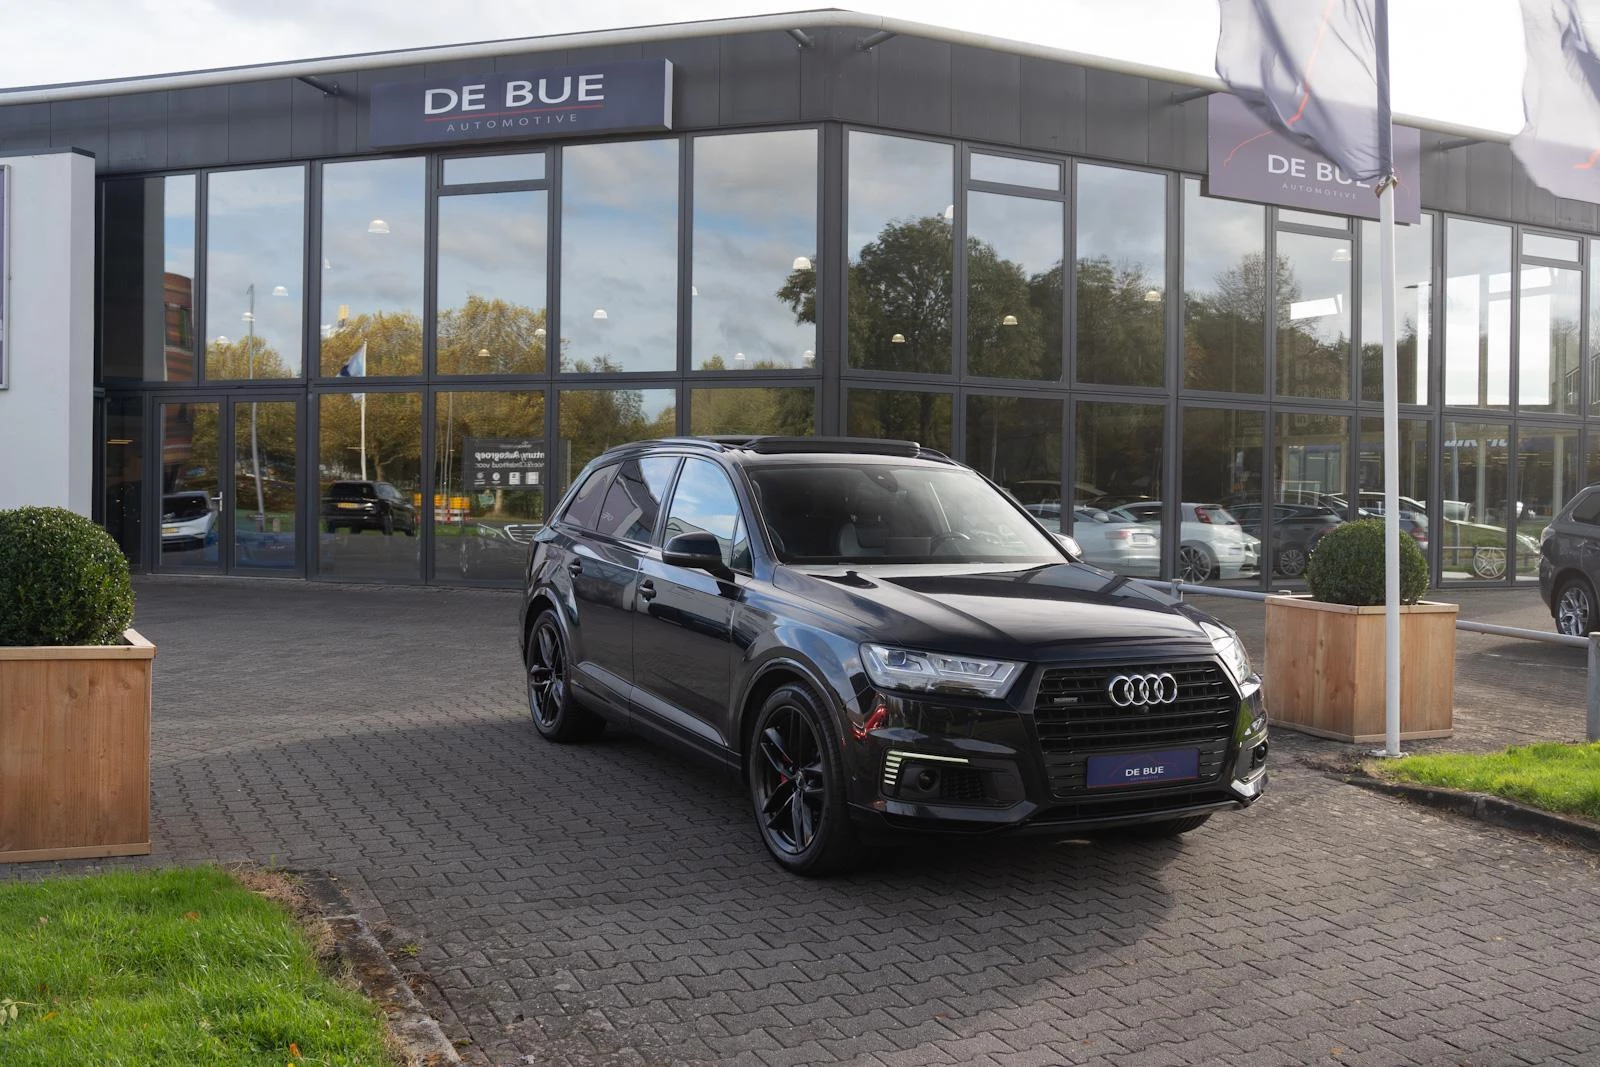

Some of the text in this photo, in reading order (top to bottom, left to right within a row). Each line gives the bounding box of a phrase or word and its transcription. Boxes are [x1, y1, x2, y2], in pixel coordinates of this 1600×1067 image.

[424, 74, 605, 115] DE BUE
[447, 113, 578, 133] AUTOMOTIVE
[1267, 154, 1371, 188] DE BU
[1282, 183, 1357, 200] AUTOMOTIVE
[1125, 766, 1164, 777] DE BUE
